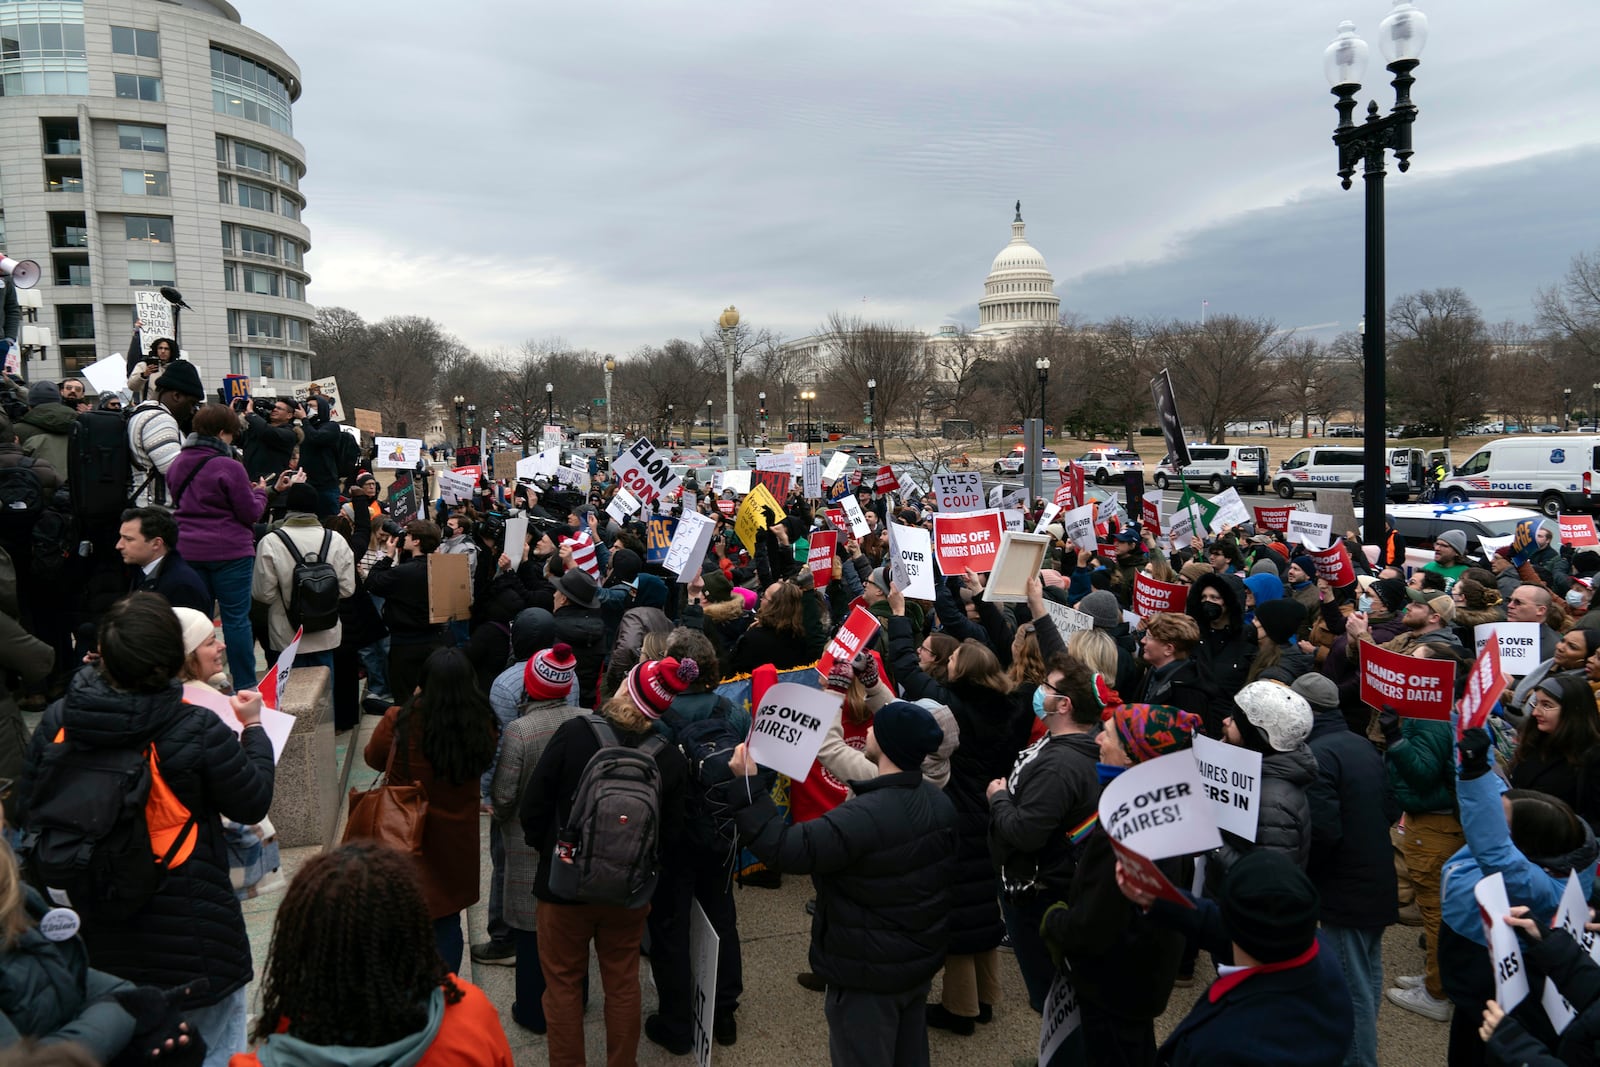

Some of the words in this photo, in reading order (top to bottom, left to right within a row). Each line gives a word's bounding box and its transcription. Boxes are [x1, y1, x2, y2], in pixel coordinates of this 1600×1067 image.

[138, 293, 147, 301] IF
[150, 311, 166, 320] BAD
[630, 438, 676, 490] ELON
[623, 468, 660, 506] CON
[937, 474, 978, 486] THIS
[943, 494, 979, 508] COUP
[854, 517, 862, 525] IN
[1005, 520, 1020, 528] OVER
[1290, 520, 1313, 528] WORKERS
[1313, 522, 1328, 530] OVER
[940, 533, 967, 545] HANDS
[968, 530, 991, 541] OFF
[901, 550, 924, 562] OVER
[941, 545, 968, 557] WORKERS
[970, 542, 995, 555] DATA!
[1137, 581, 1172, 599] NOBODY
[1136, 592, 1170, 609] ELECTED
[1050, 602, 1069, 618] TAKE
[1074, 613, 1089, 628] YOUR
[1506, 638, 1533, 646] OVER
[1367, 660, 1406, 685] HANDS
[1408, 675, 1440, 688] OFF
[1366, 672, 1404, 700] WORKERS
[1407, 688, 1443, 702] DATA!
[779, 707, 821, 732] OVER
[754, 719, 802, 746] AIRES!
[1231, 771, 1255, 792] OUT
[1134, 782, 1191, 808] OVER
[1234, 793, 1249, 811] IN
